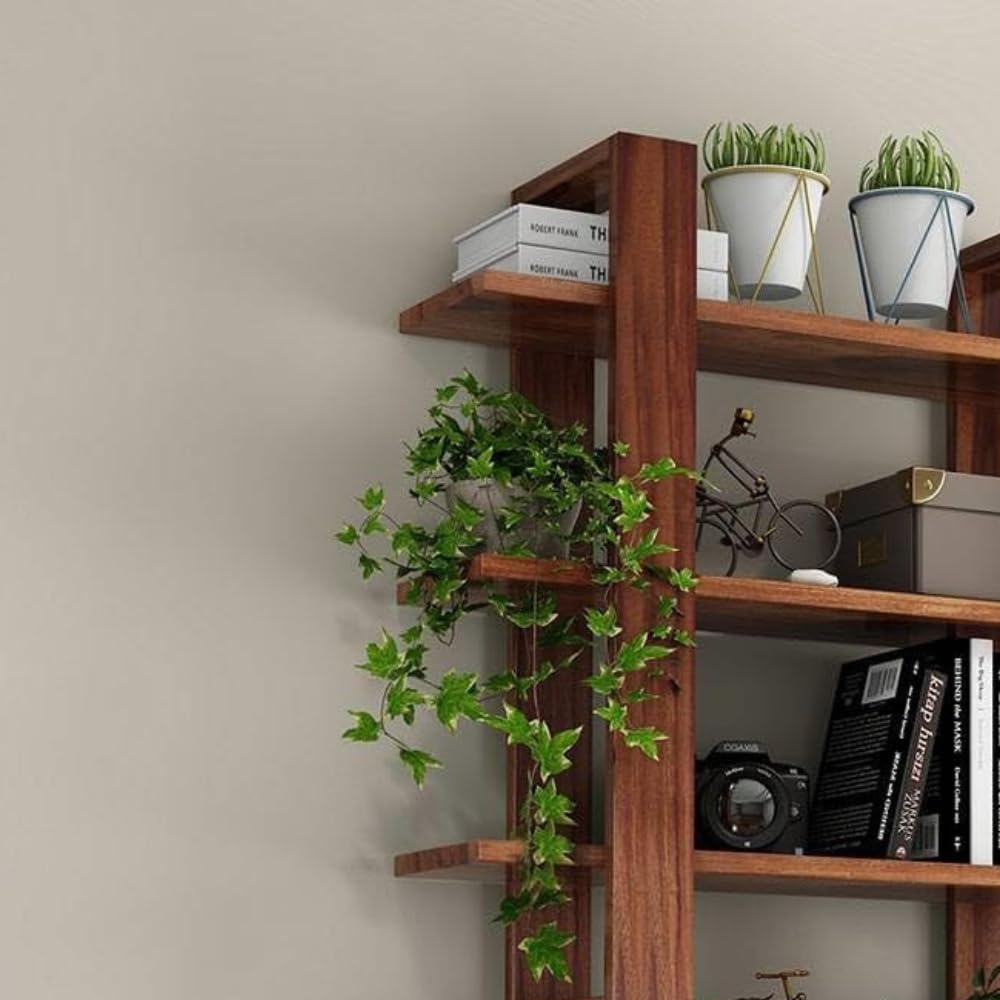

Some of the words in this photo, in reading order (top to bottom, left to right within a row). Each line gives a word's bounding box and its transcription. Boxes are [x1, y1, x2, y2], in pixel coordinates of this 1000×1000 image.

[530, 223, 556, 234] ROBERT
[557, 227, 579, 238] FRANK
[589, 225, 607, 241] TH
[530, 263, 556, 274] ROBERT
[556, 267, 579, 278] FRANK
[589, 265, 607, 282] TH
[953, 657, 963, 702] BEHIND
[921, 673, 946, 724] kitap
[953, 704, 963, 719] the
[953, 721, 963, 753] MASK
